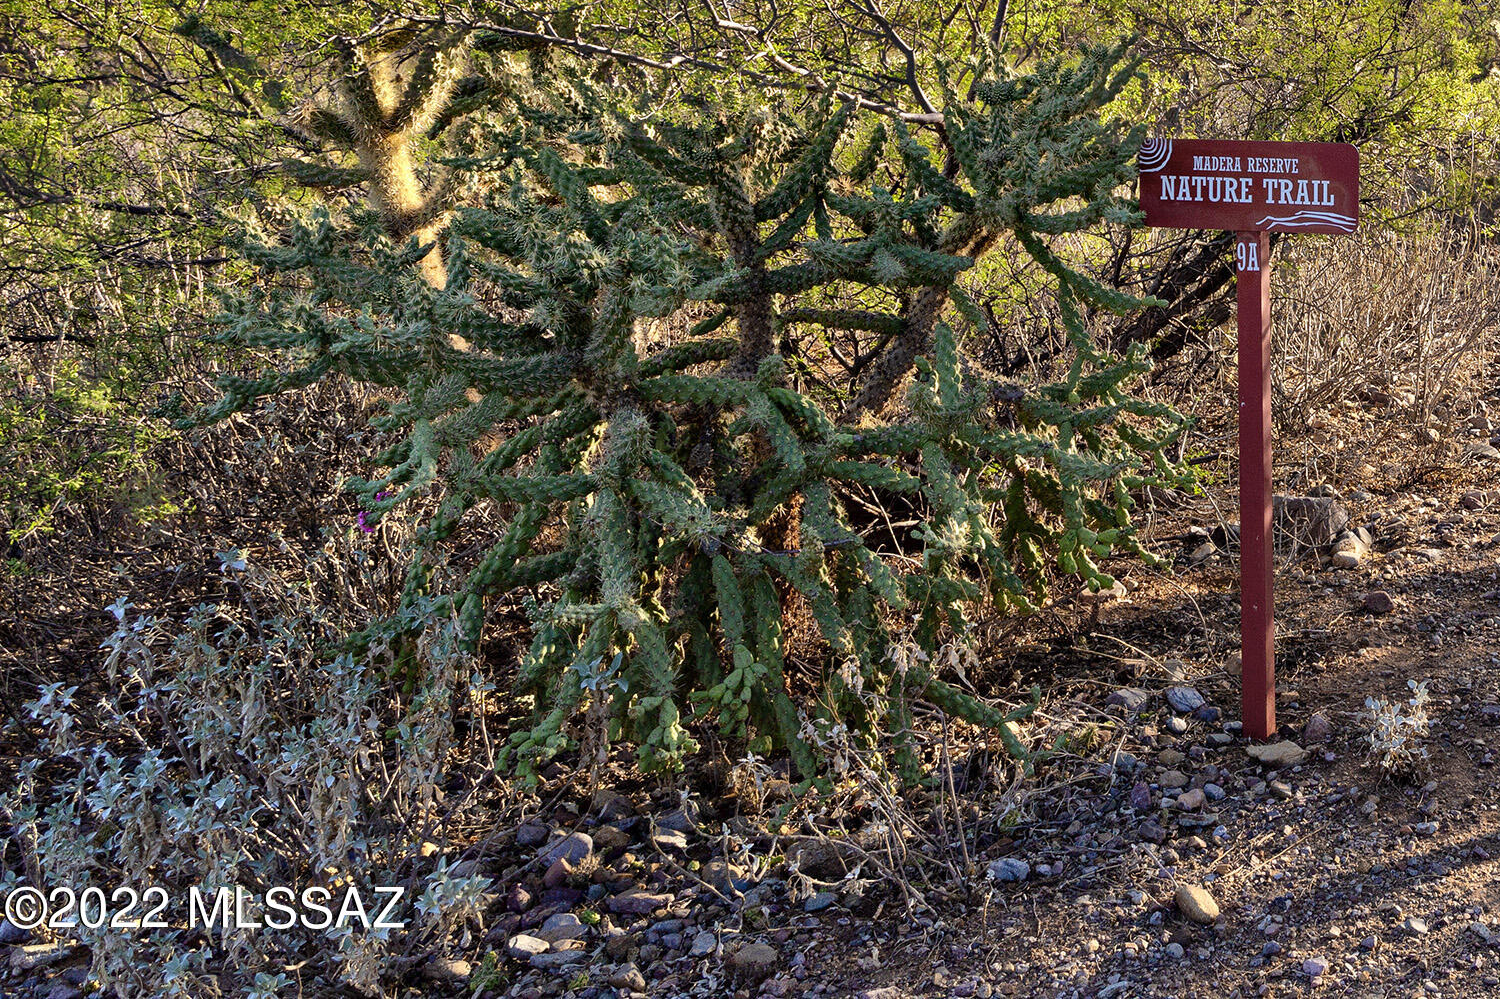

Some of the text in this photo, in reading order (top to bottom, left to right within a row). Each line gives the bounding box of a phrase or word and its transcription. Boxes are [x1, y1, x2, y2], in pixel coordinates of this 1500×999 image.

[1193, 156, 1299, 174] MADERA RESERVE
[1160, 175, 1335, 206] NATURE TRAIL
[1237, 242, 1260, 272] 9A
